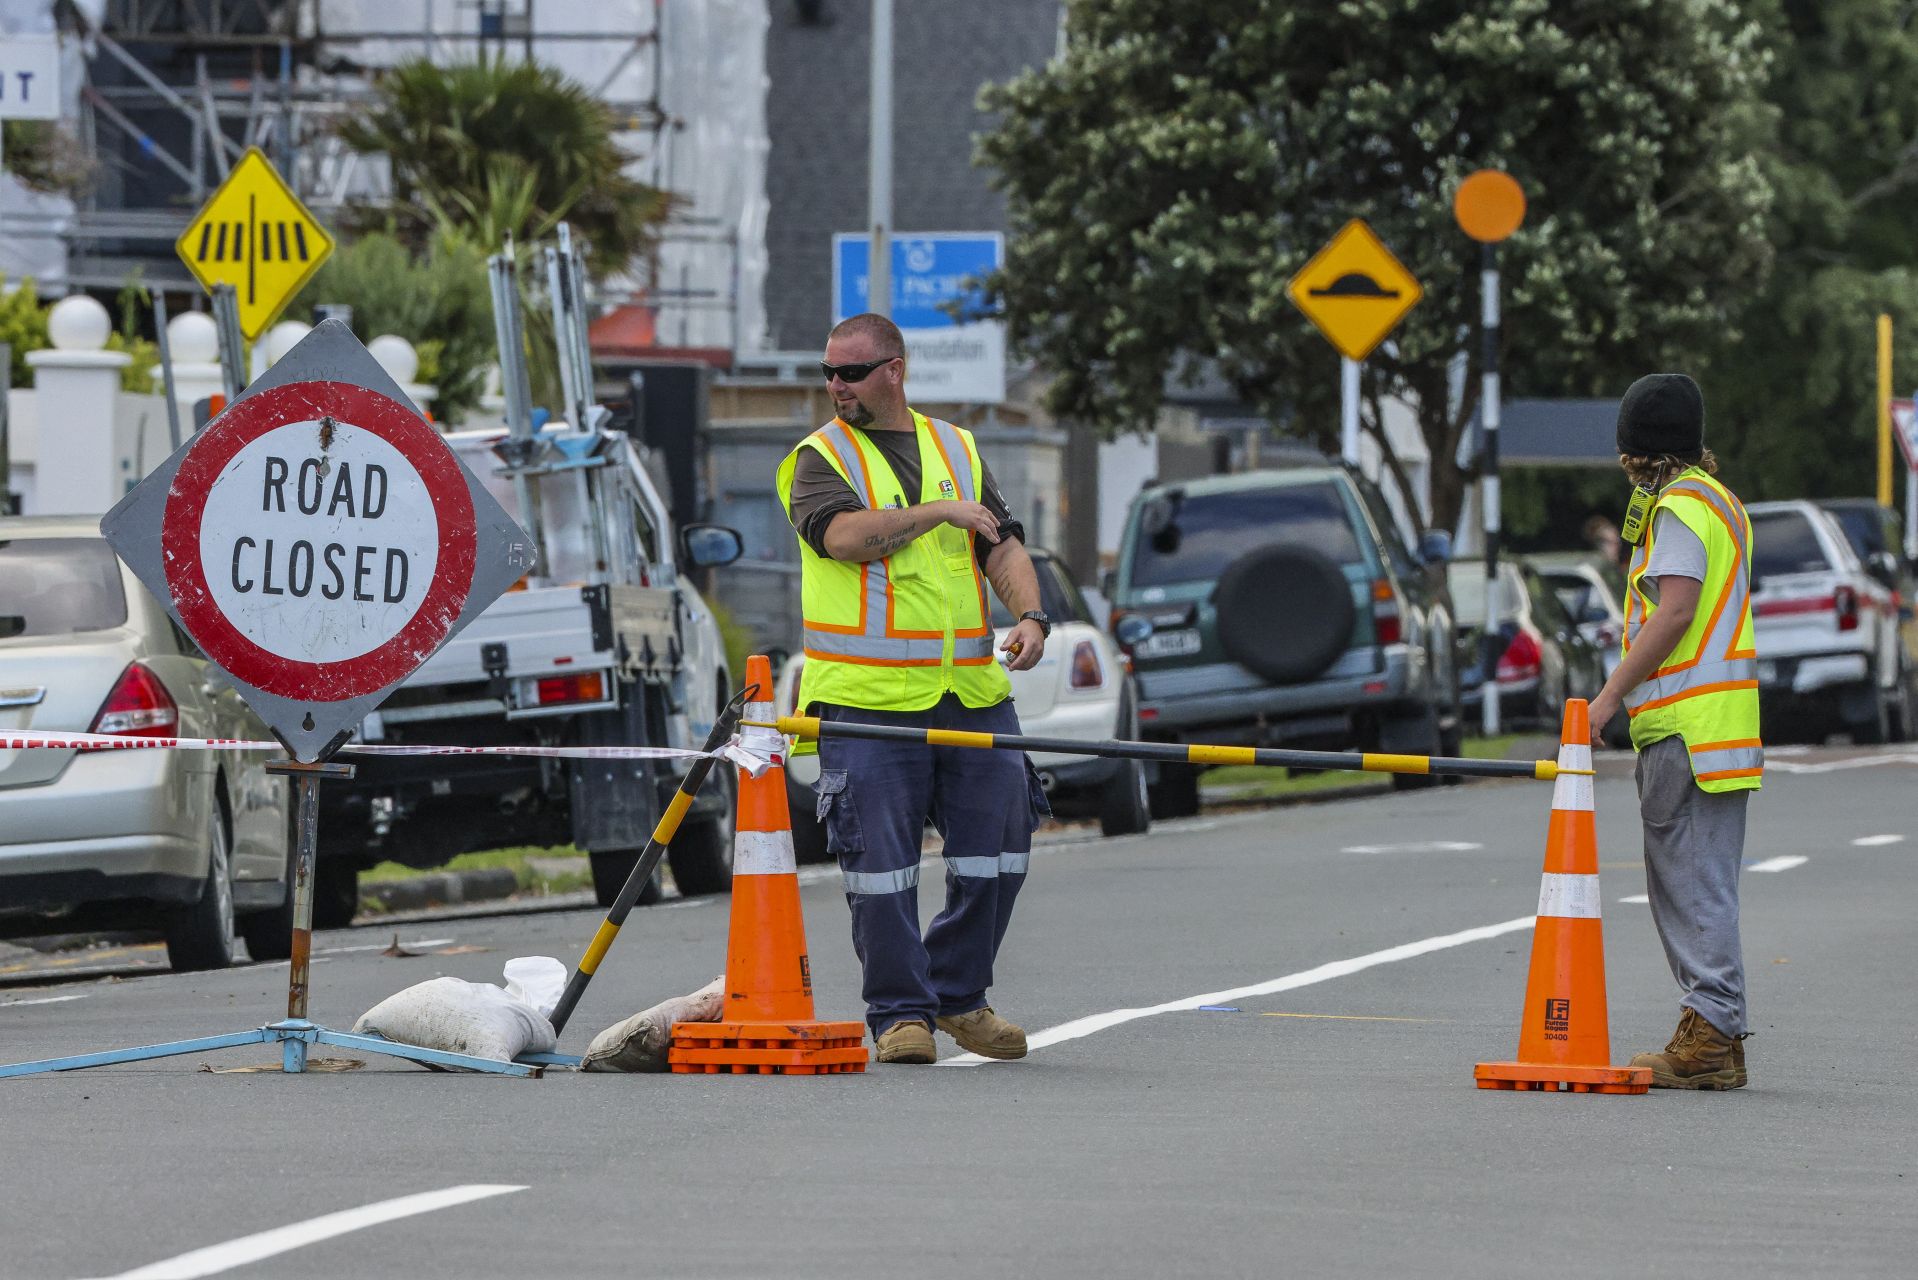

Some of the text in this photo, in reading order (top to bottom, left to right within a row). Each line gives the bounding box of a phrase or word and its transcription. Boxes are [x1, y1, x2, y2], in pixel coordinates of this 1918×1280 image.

[0, 71, 35, 102] T
[263, 456, 388, 519] ROAD
[231, 536, 409, 604] CLOSED
[1544, 1033, 1568, 1041] 30400
